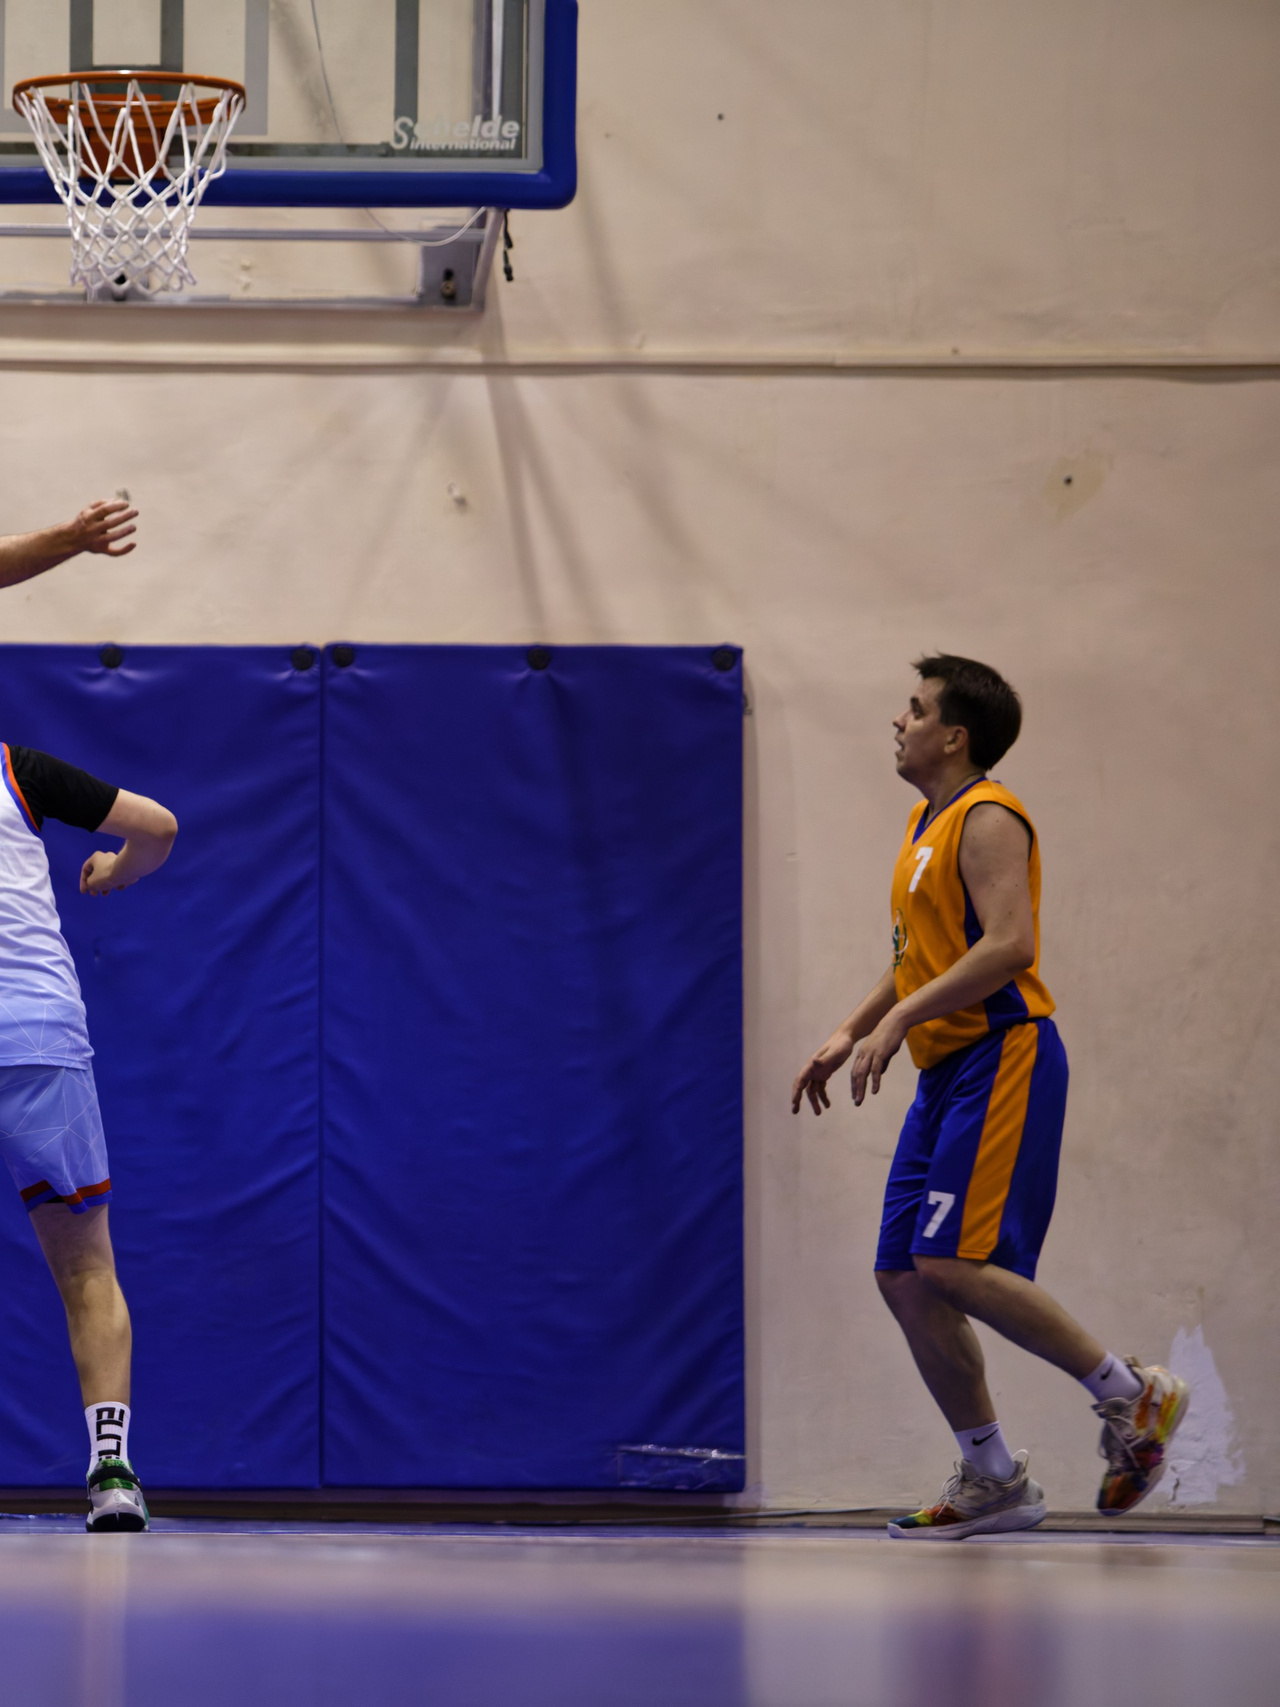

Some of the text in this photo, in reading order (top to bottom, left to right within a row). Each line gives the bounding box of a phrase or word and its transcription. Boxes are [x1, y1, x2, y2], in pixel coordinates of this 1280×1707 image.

[389, 114, 520, 149] Schelde
[908, 846, 934, 893] 7
[922, 1190, 956, 1239] 7
[95, 1407, 126, 1462] ELIT
